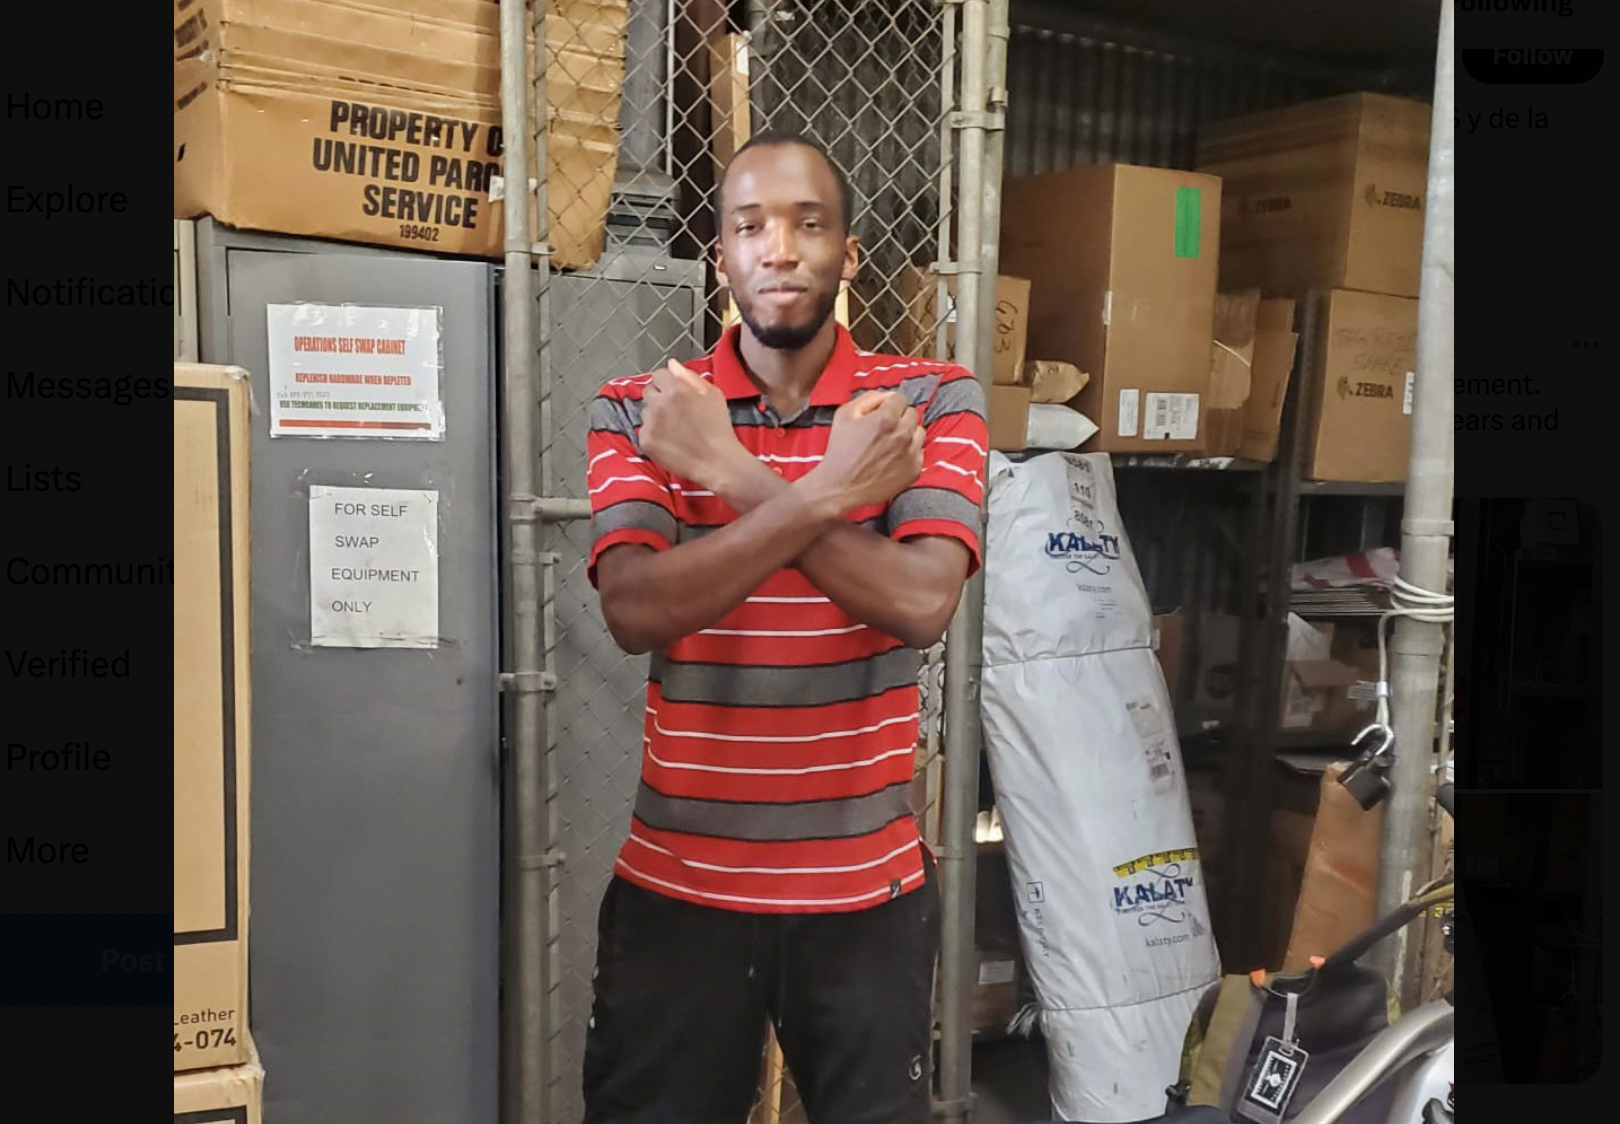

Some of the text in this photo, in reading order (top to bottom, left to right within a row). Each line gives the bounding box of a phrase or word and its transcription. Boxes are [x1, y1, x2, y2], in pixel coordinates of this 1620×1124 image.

[330, 100, 478, 153] PROPERTY
[313, 137, 419, 184] UNITED
[362, 183, 478, 229] SERVICE
[1382, 190, 1421, 211] ZEBRA
[400, 224, 439, 243] 199402
[294, 335, 406, 356] OPERATIONS SELF SWAP CABINET
[1355, 382, 1394, 400] ZEBRA
[1073, 482, 1092, 499] 110
[334, 503, 408, 517] FOR SELF
[334, 535, 380, 549] SWAP
[331, 567, 420, 582] EQUIPMENT
[331, 600, 373, 613] ONLY
